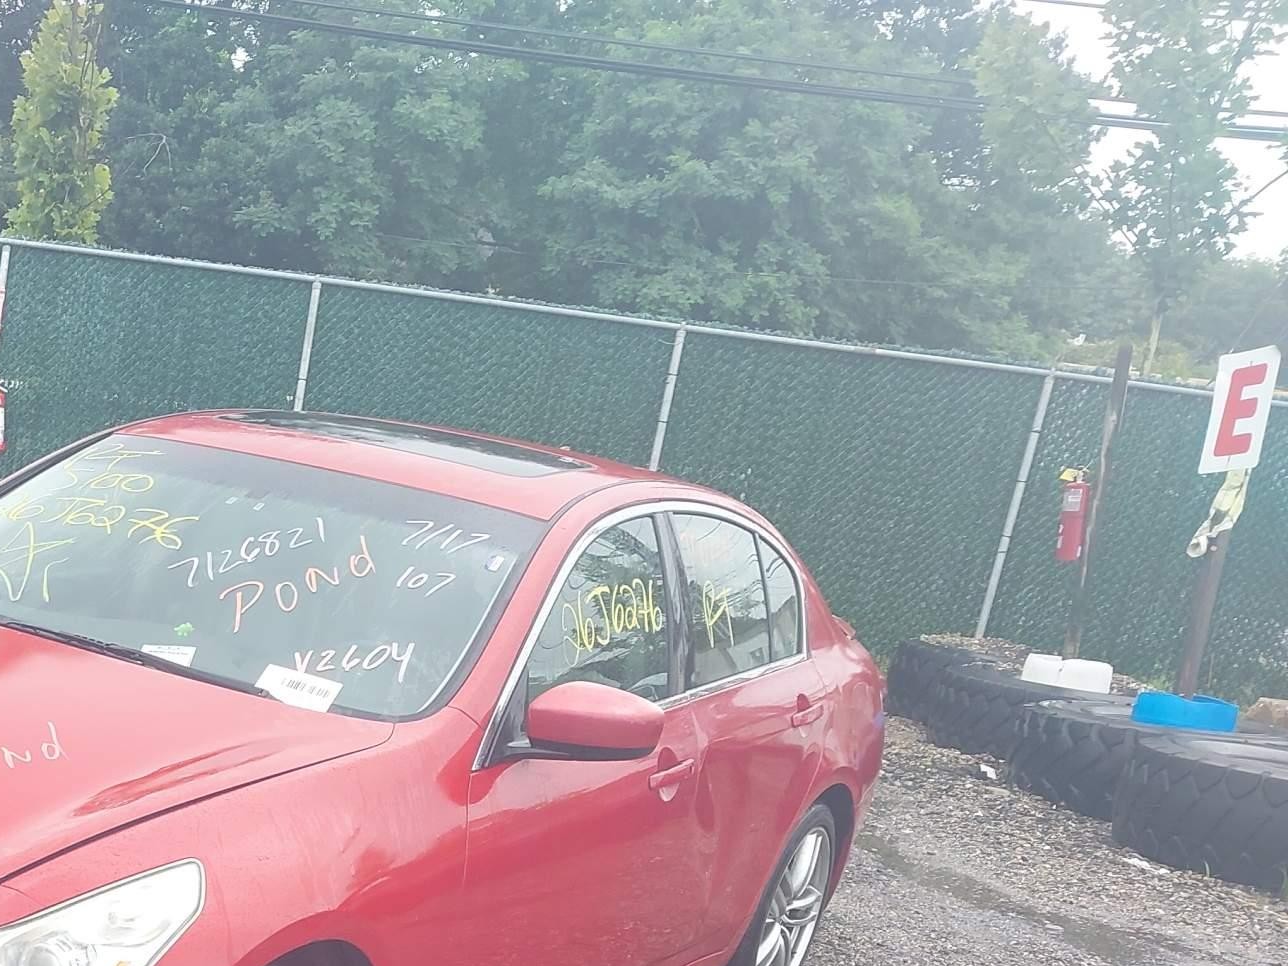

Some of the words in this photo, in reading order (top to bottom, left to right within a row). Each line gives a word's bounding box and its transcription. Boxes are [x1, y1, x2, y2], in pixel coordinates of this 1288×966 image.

[1213, 363, 1268, 457] E
[168, 517, 326, 588] 7126821
[396, 566, 457, 597] 107
